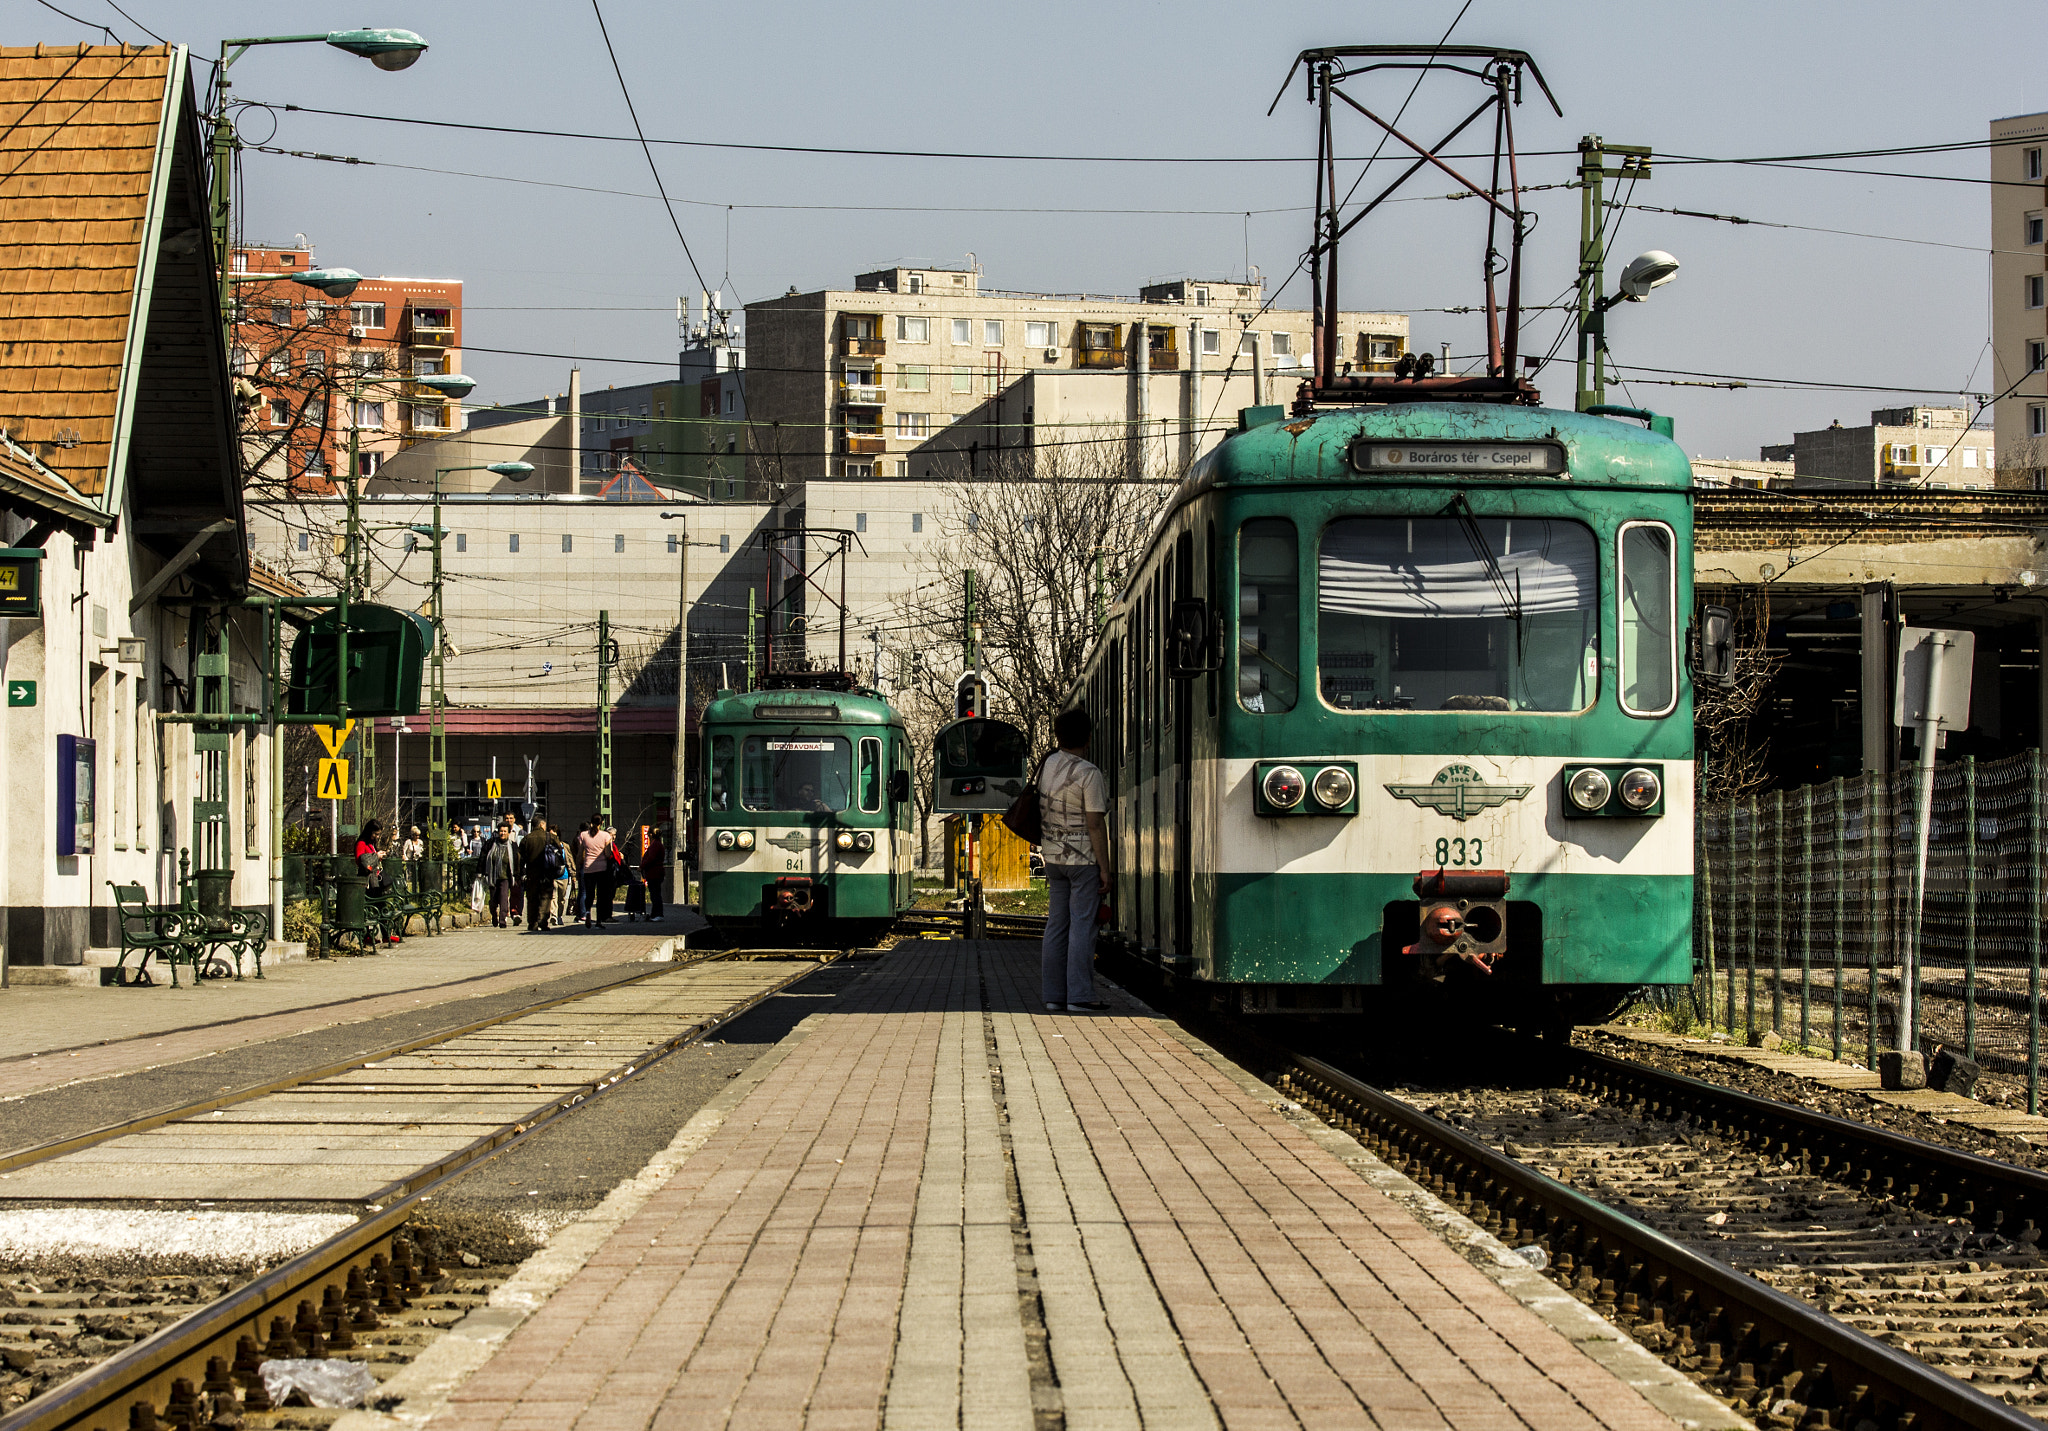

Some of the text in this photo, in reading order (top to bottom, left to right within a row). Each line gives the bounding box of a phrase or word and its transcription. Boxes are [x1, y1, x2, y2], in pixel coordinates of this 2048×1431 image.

[1409, 451, 1458, 463] Boráros
[1462, 451, 1480, 463] tér
[1491, 452, 1532, 466] Csepel
[1435, 837, 1483, 866] 833
[786, 858, 803, 871] 841
